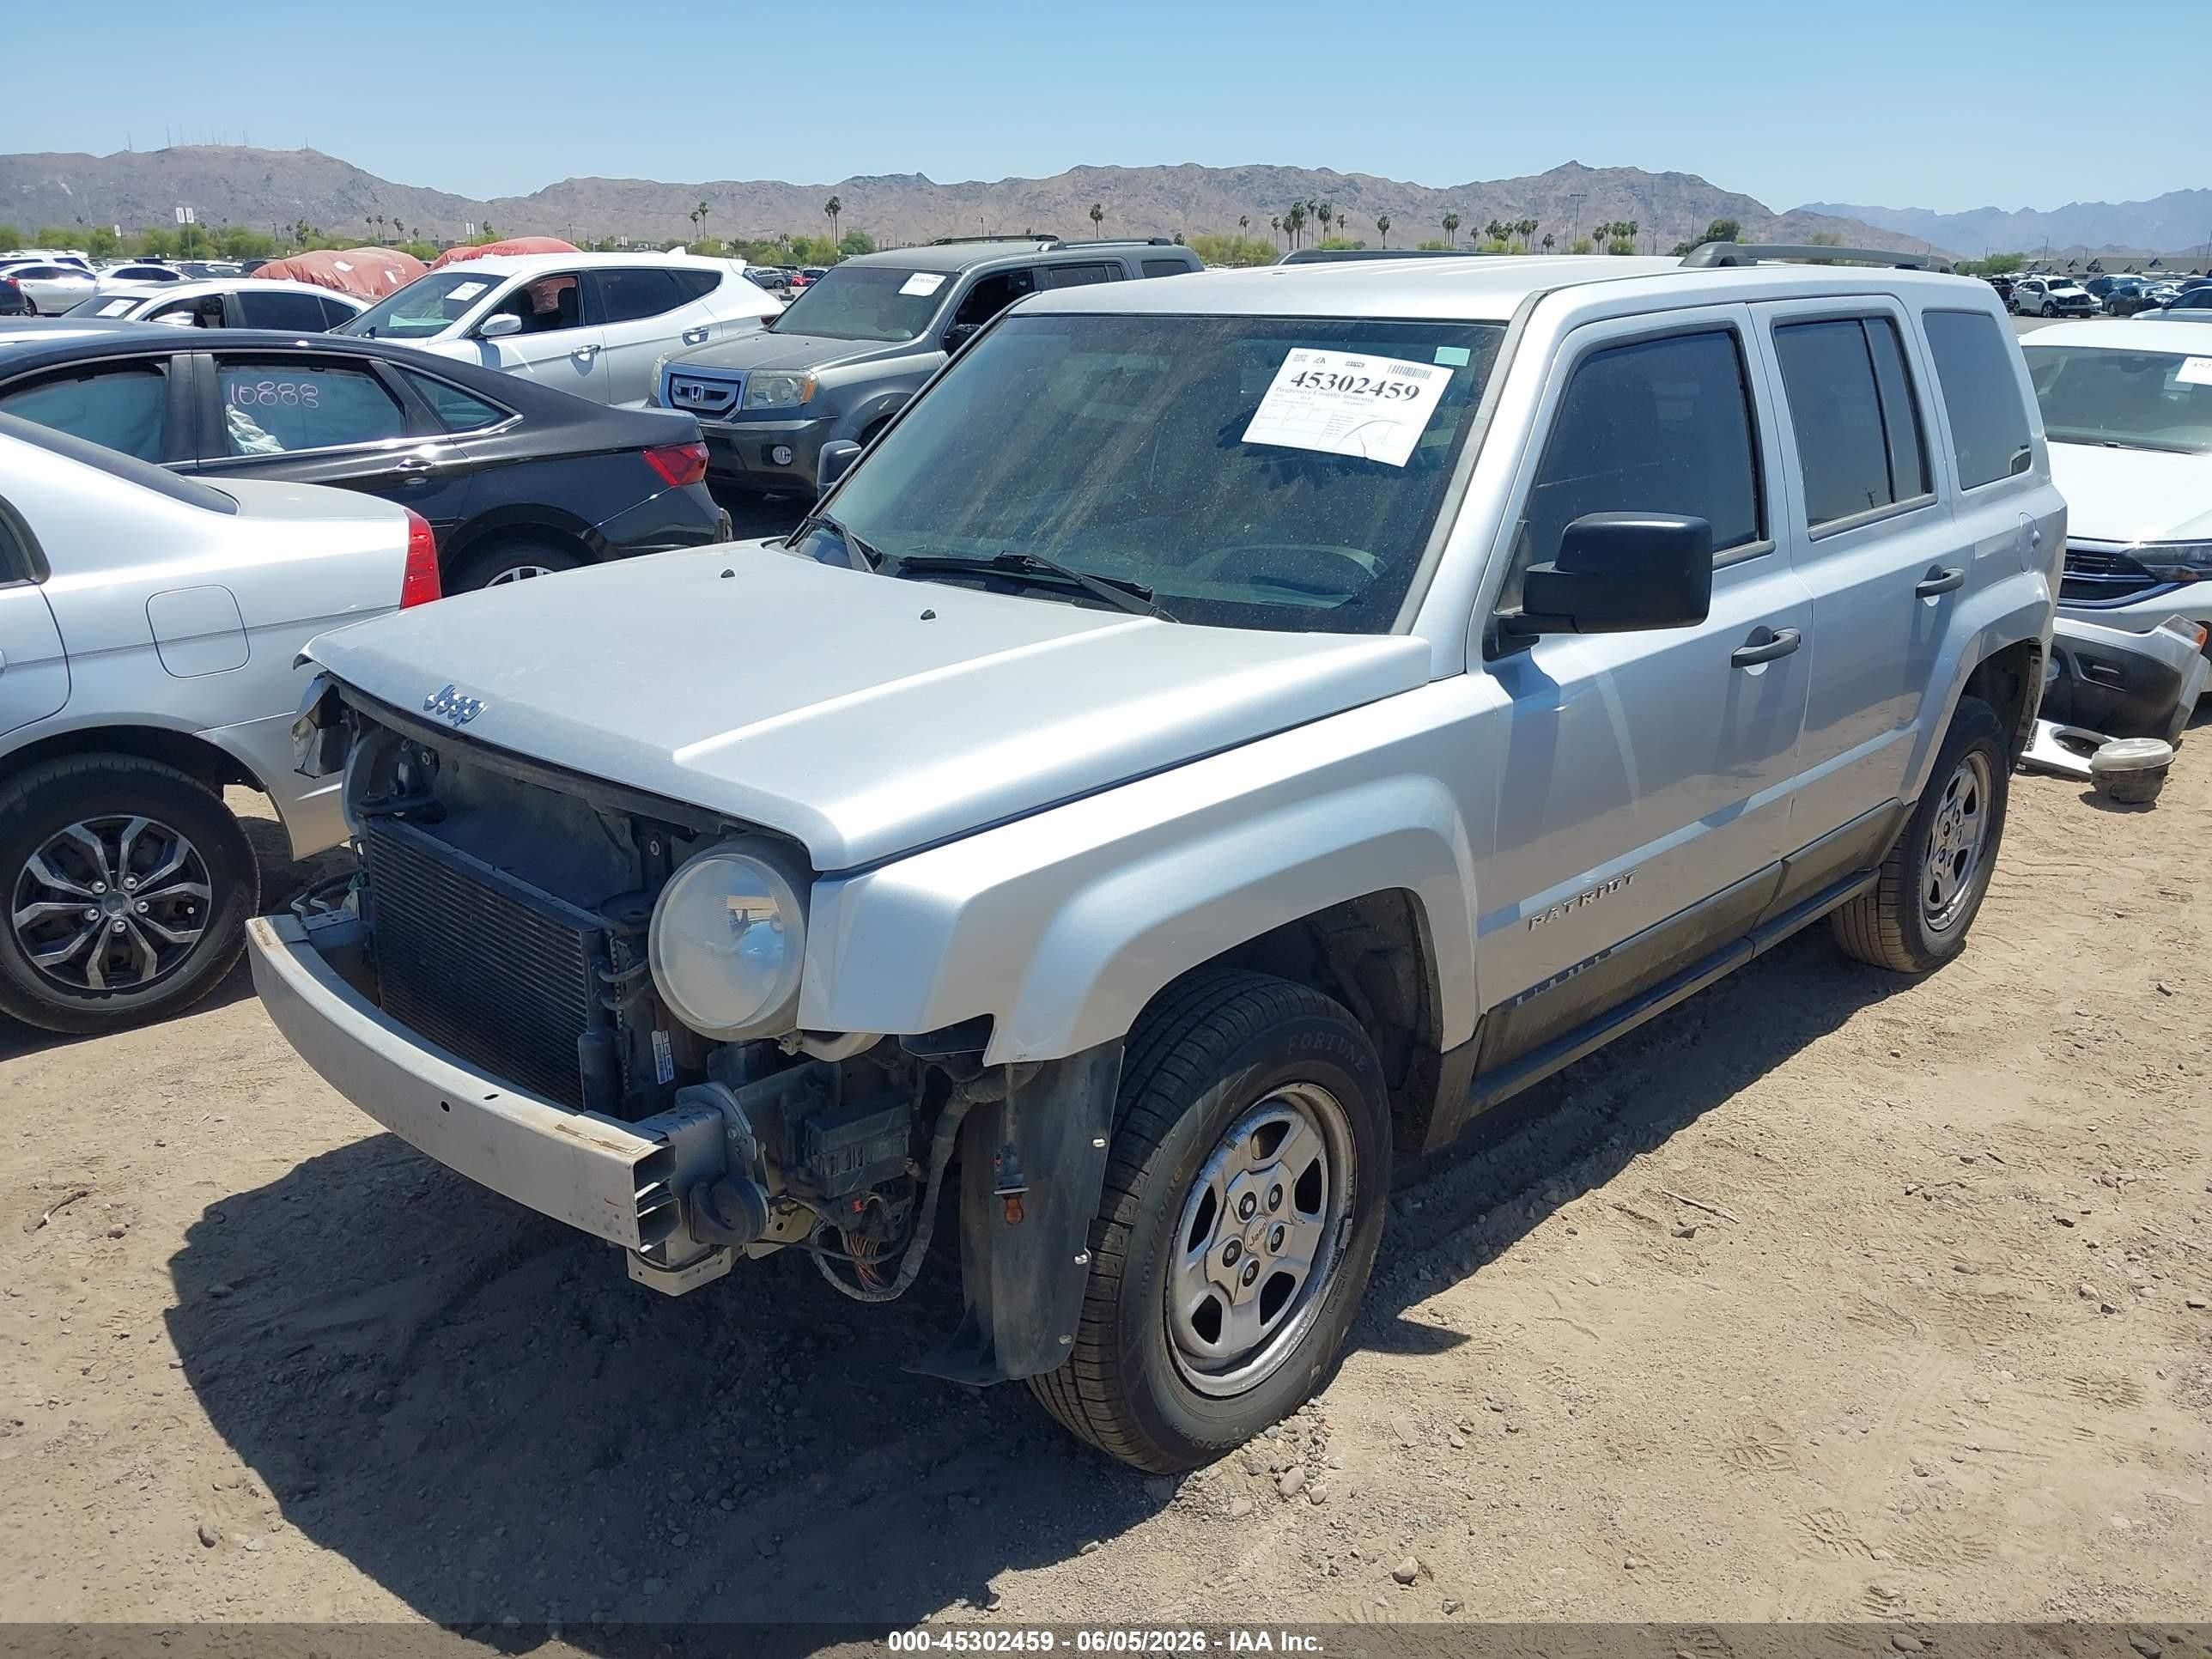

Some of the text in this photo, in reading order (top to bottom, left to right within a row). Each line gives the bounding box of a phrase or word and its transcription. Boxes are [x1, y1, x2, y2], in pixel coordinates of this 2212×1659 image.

[230, 380, 319, 409] 10888
[1291, 370, 1419, 401] 45302459
[422, 683, 489, 728] Jeep
[1527, 868, 1640, 933] PATRIOT
[1286, 1030, 1368, 1073] FORTUNE
[1249, 1222, 1267, 1248] Jeep
